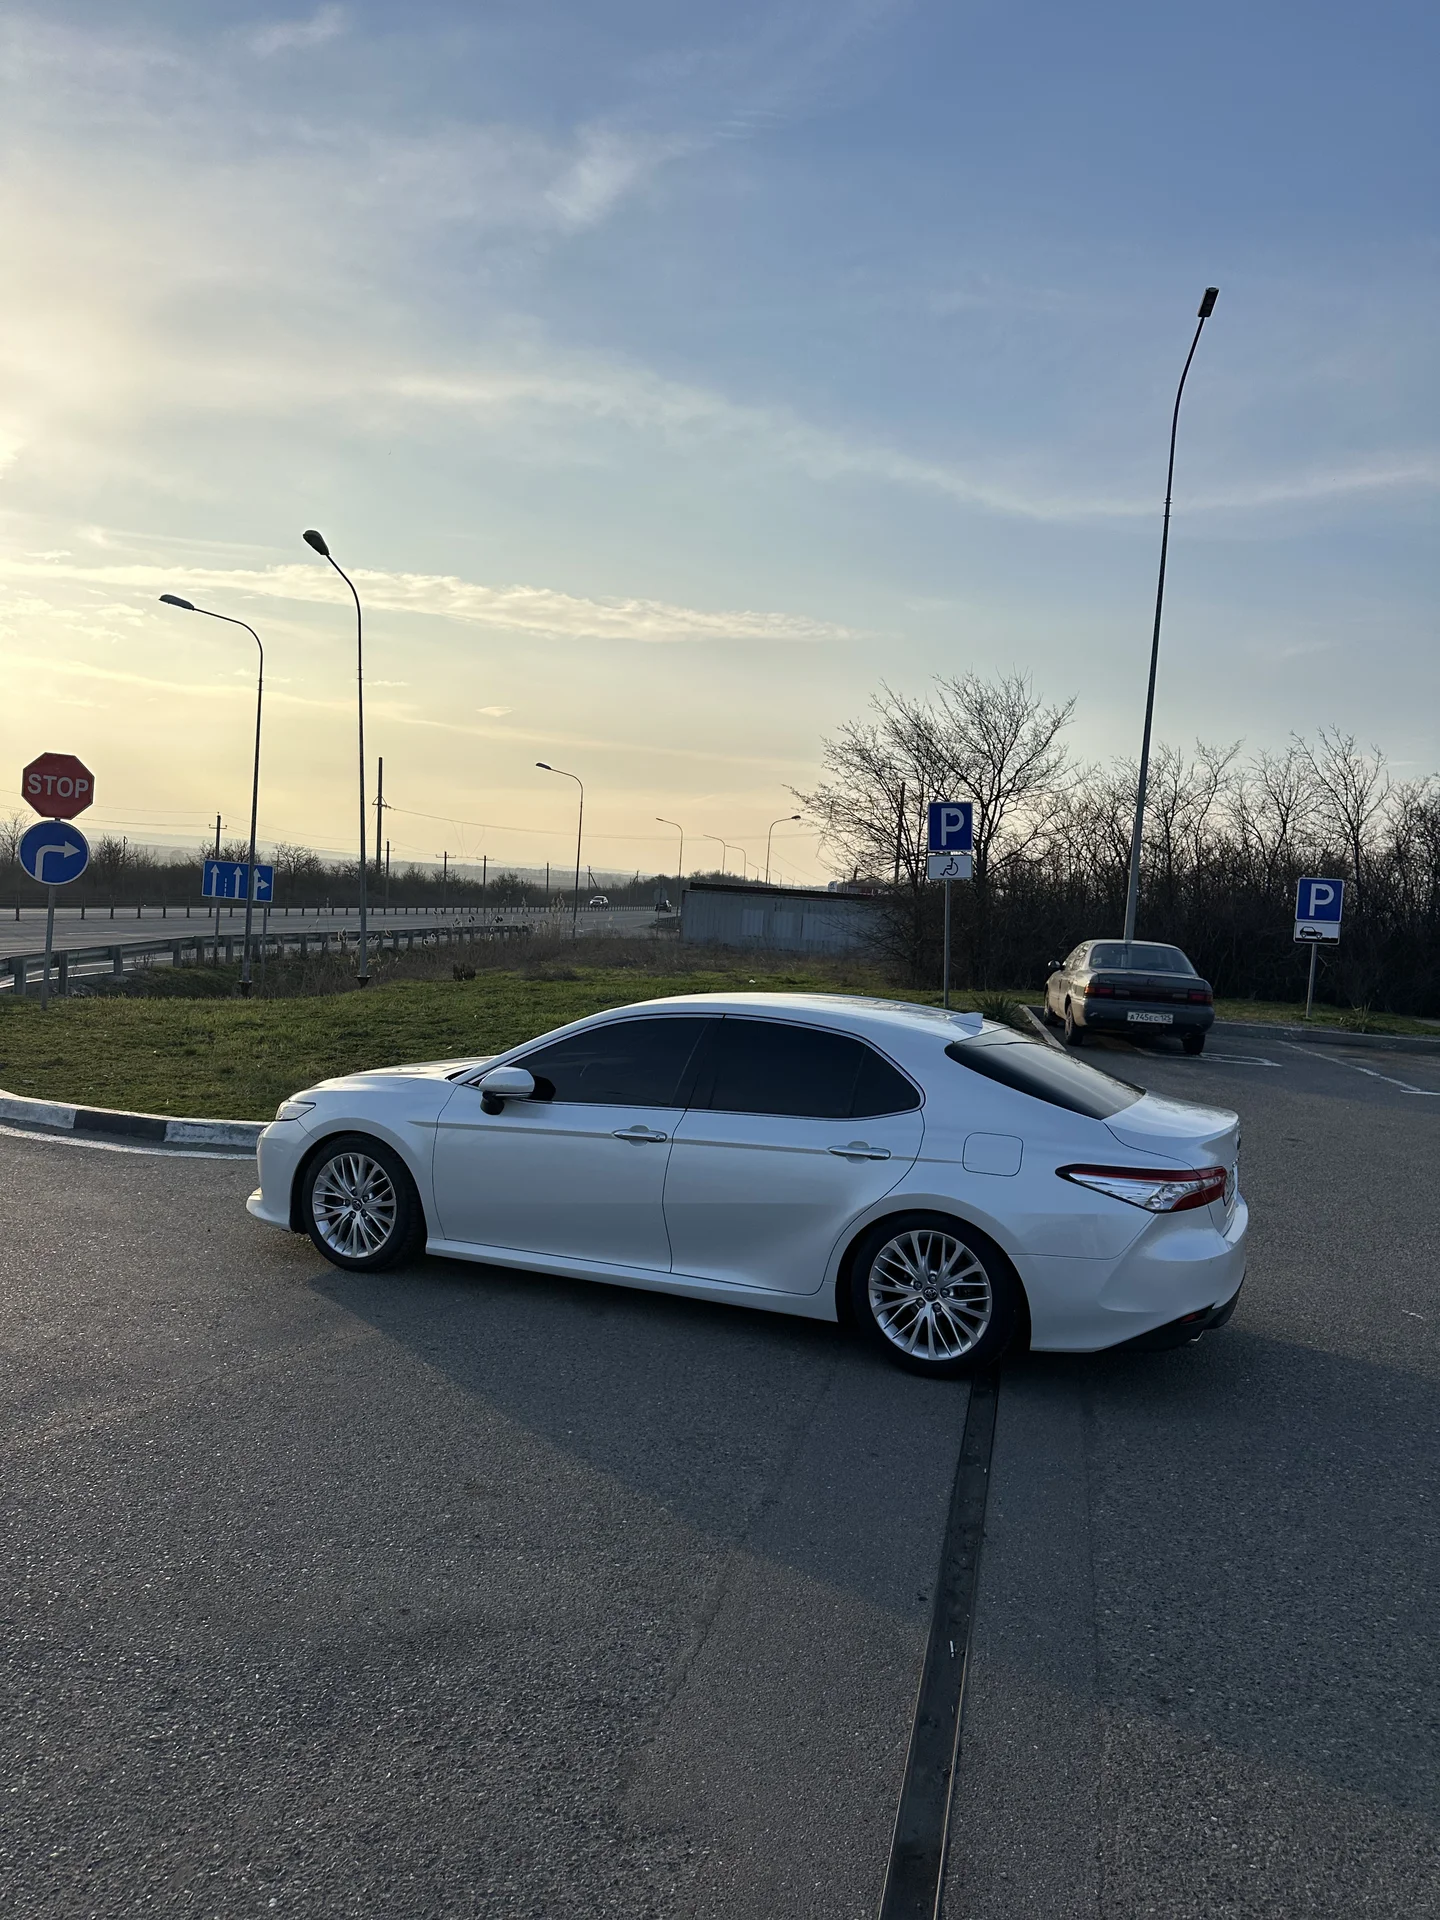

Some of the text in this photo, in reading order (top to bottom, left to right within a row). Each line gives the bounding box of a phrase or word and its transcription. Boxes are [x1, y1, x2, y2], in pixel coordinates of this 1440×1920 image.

[27, 773, 89, 799] STOP
[941, 807, 965, 847] P
[1309, 883, 1335, 917] P
